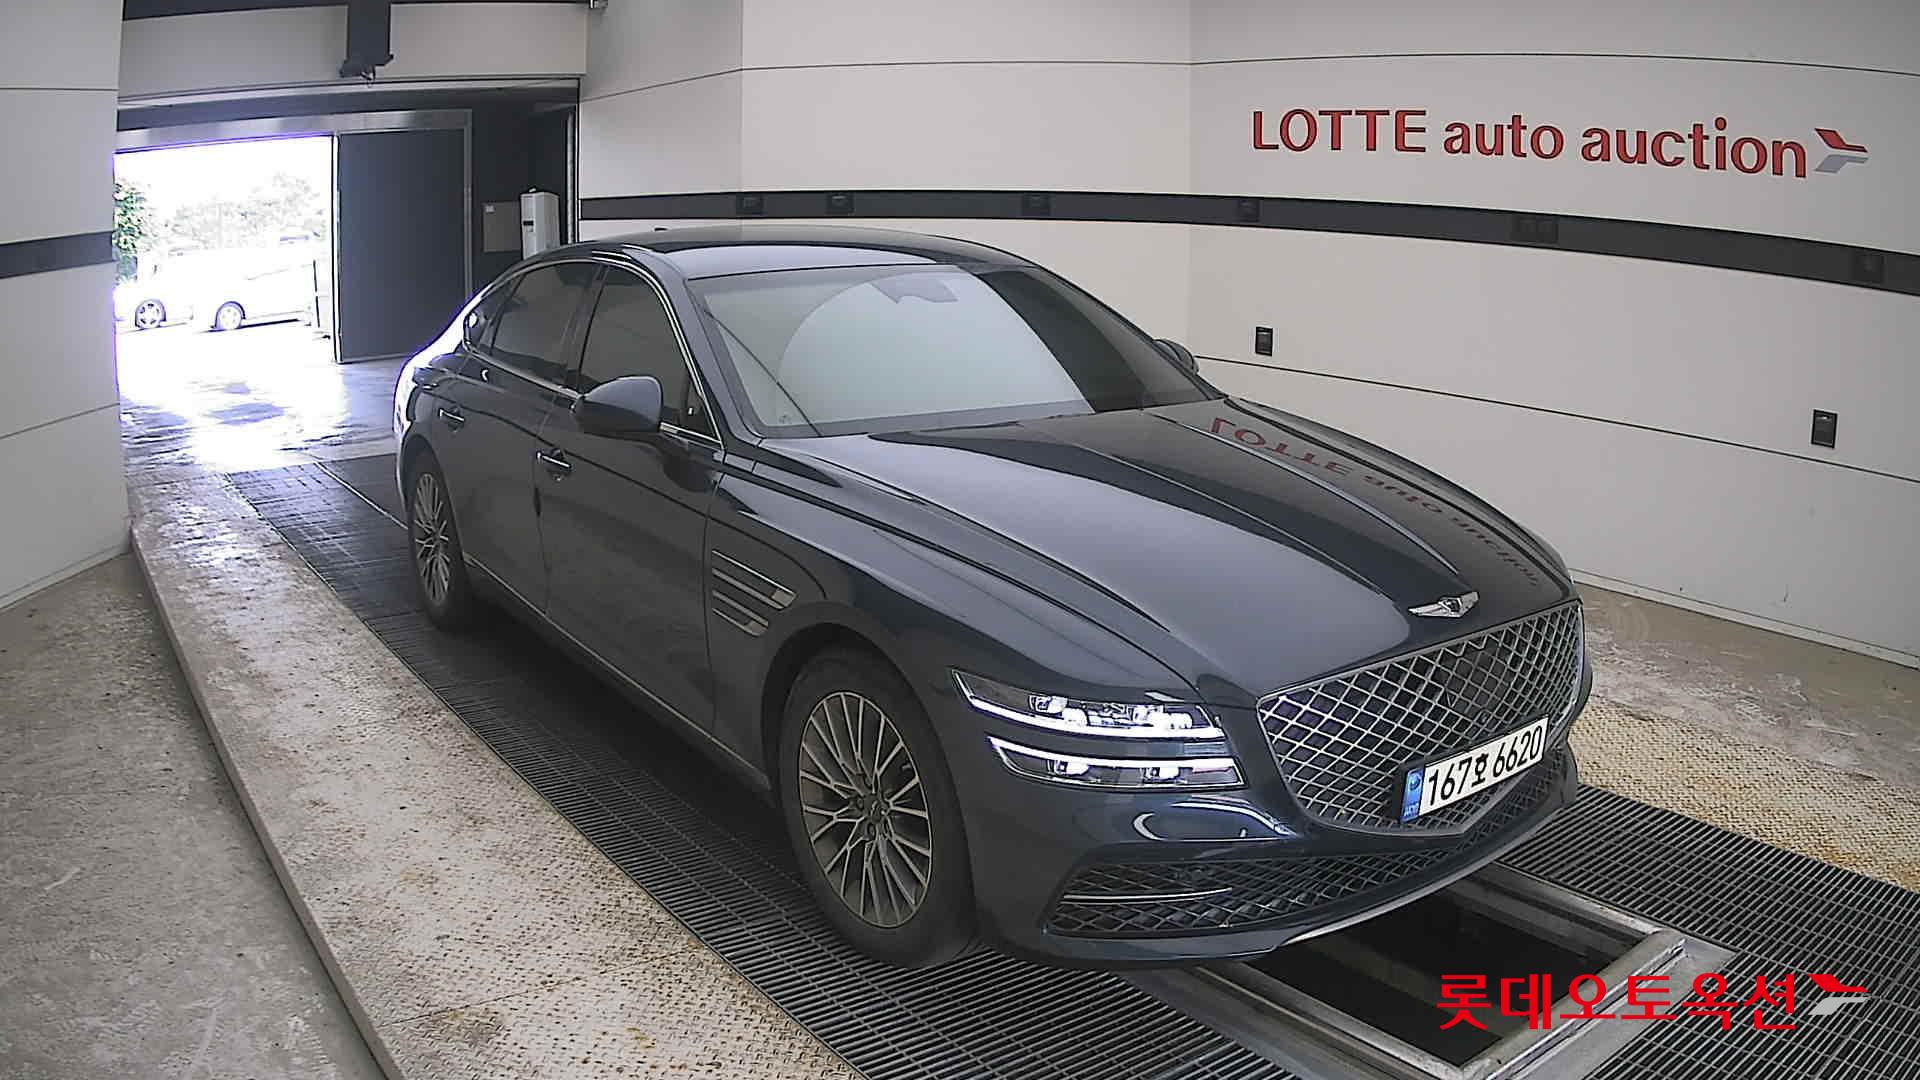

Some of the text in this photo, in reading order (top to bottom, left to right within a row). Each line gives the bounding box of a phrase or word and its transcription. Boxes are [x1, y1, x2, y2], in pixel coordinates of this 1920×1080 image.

[1252, 109, 1807, 178] LOTTE auto auction
[1492, 725, 1543, 778] 6620
